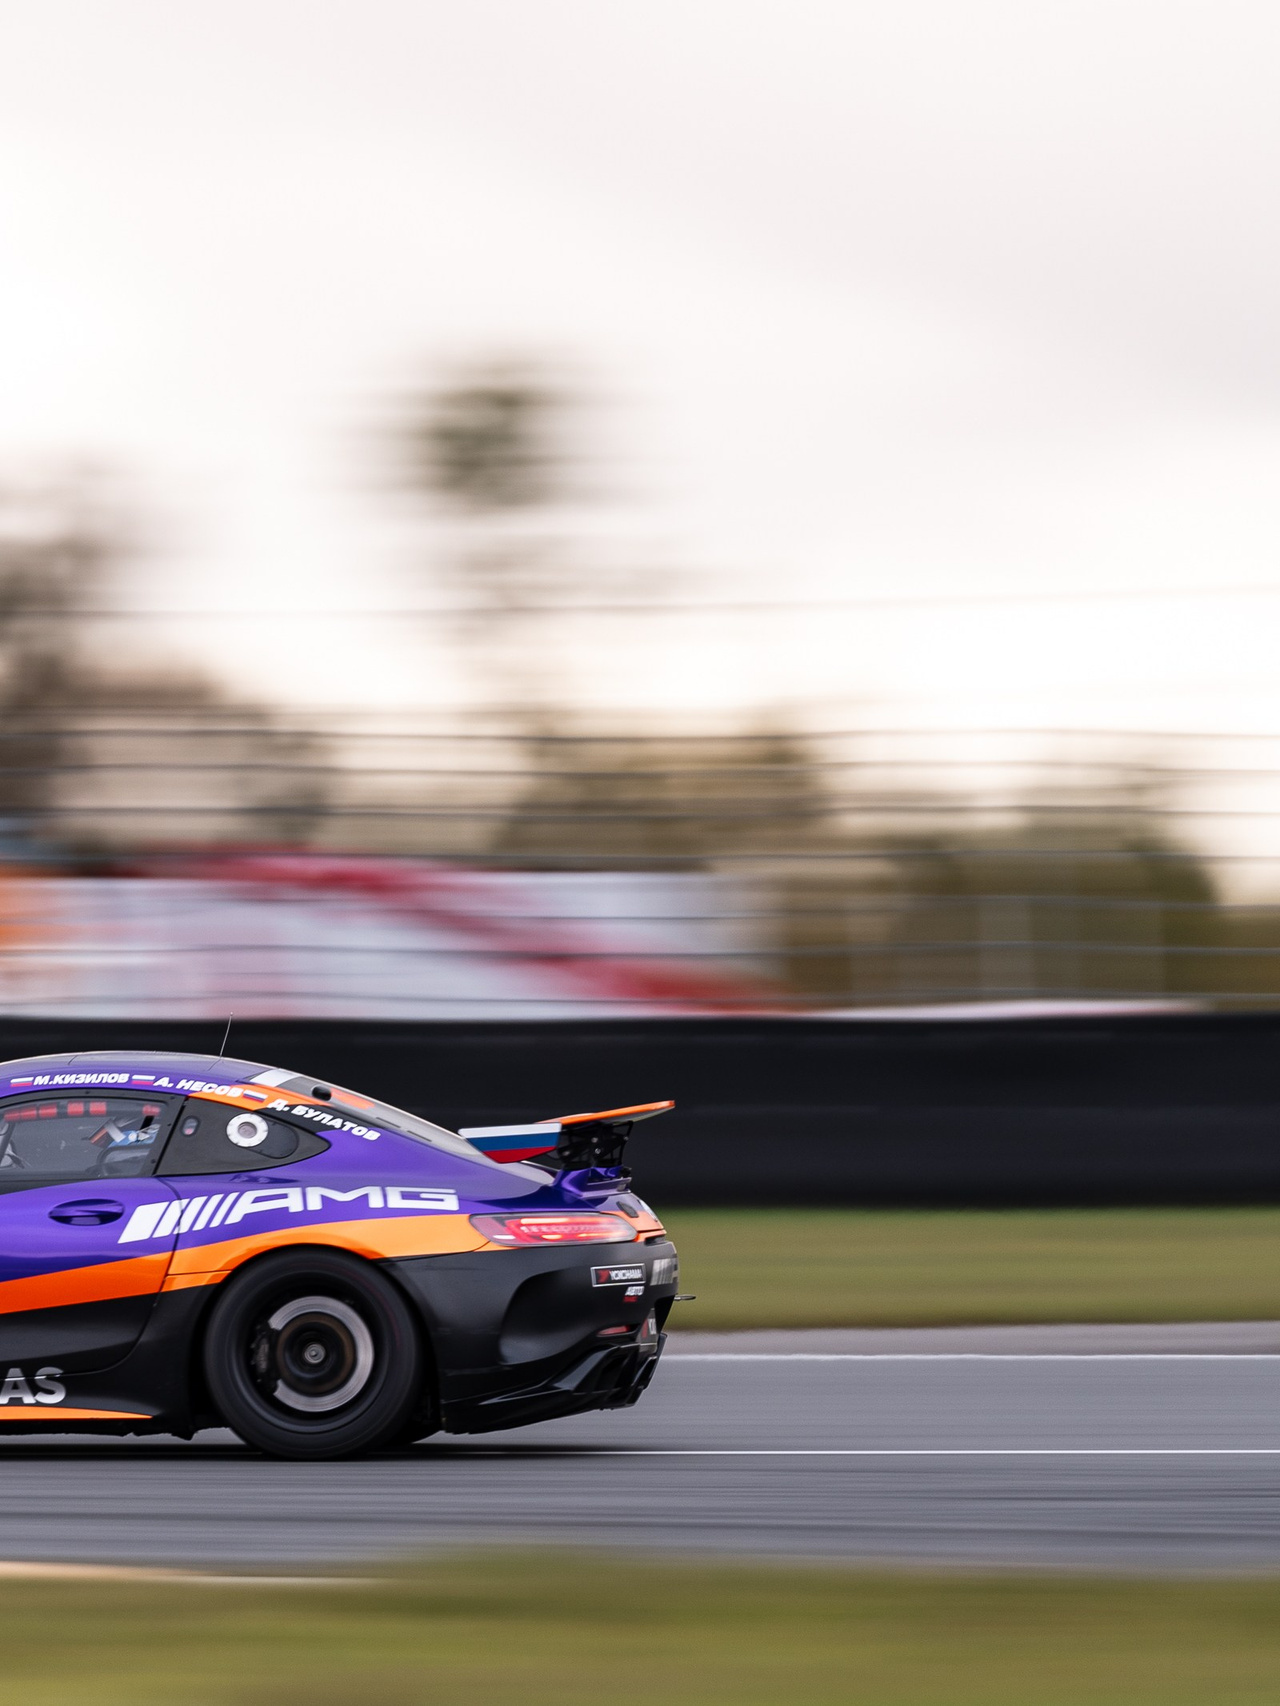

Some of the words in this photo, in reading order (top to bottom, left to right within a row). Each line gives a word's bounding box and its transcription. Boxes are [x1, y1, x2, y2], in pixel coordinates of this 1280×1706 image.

[34, 1073, 130, 1085] М.КИЗИЛОВ
[176, 1079, 243, 1097] НЕСОВ
[291, 1105, 380, 1140] БУЛАТОВ
[224, 1186, 460, 1225] AMG
